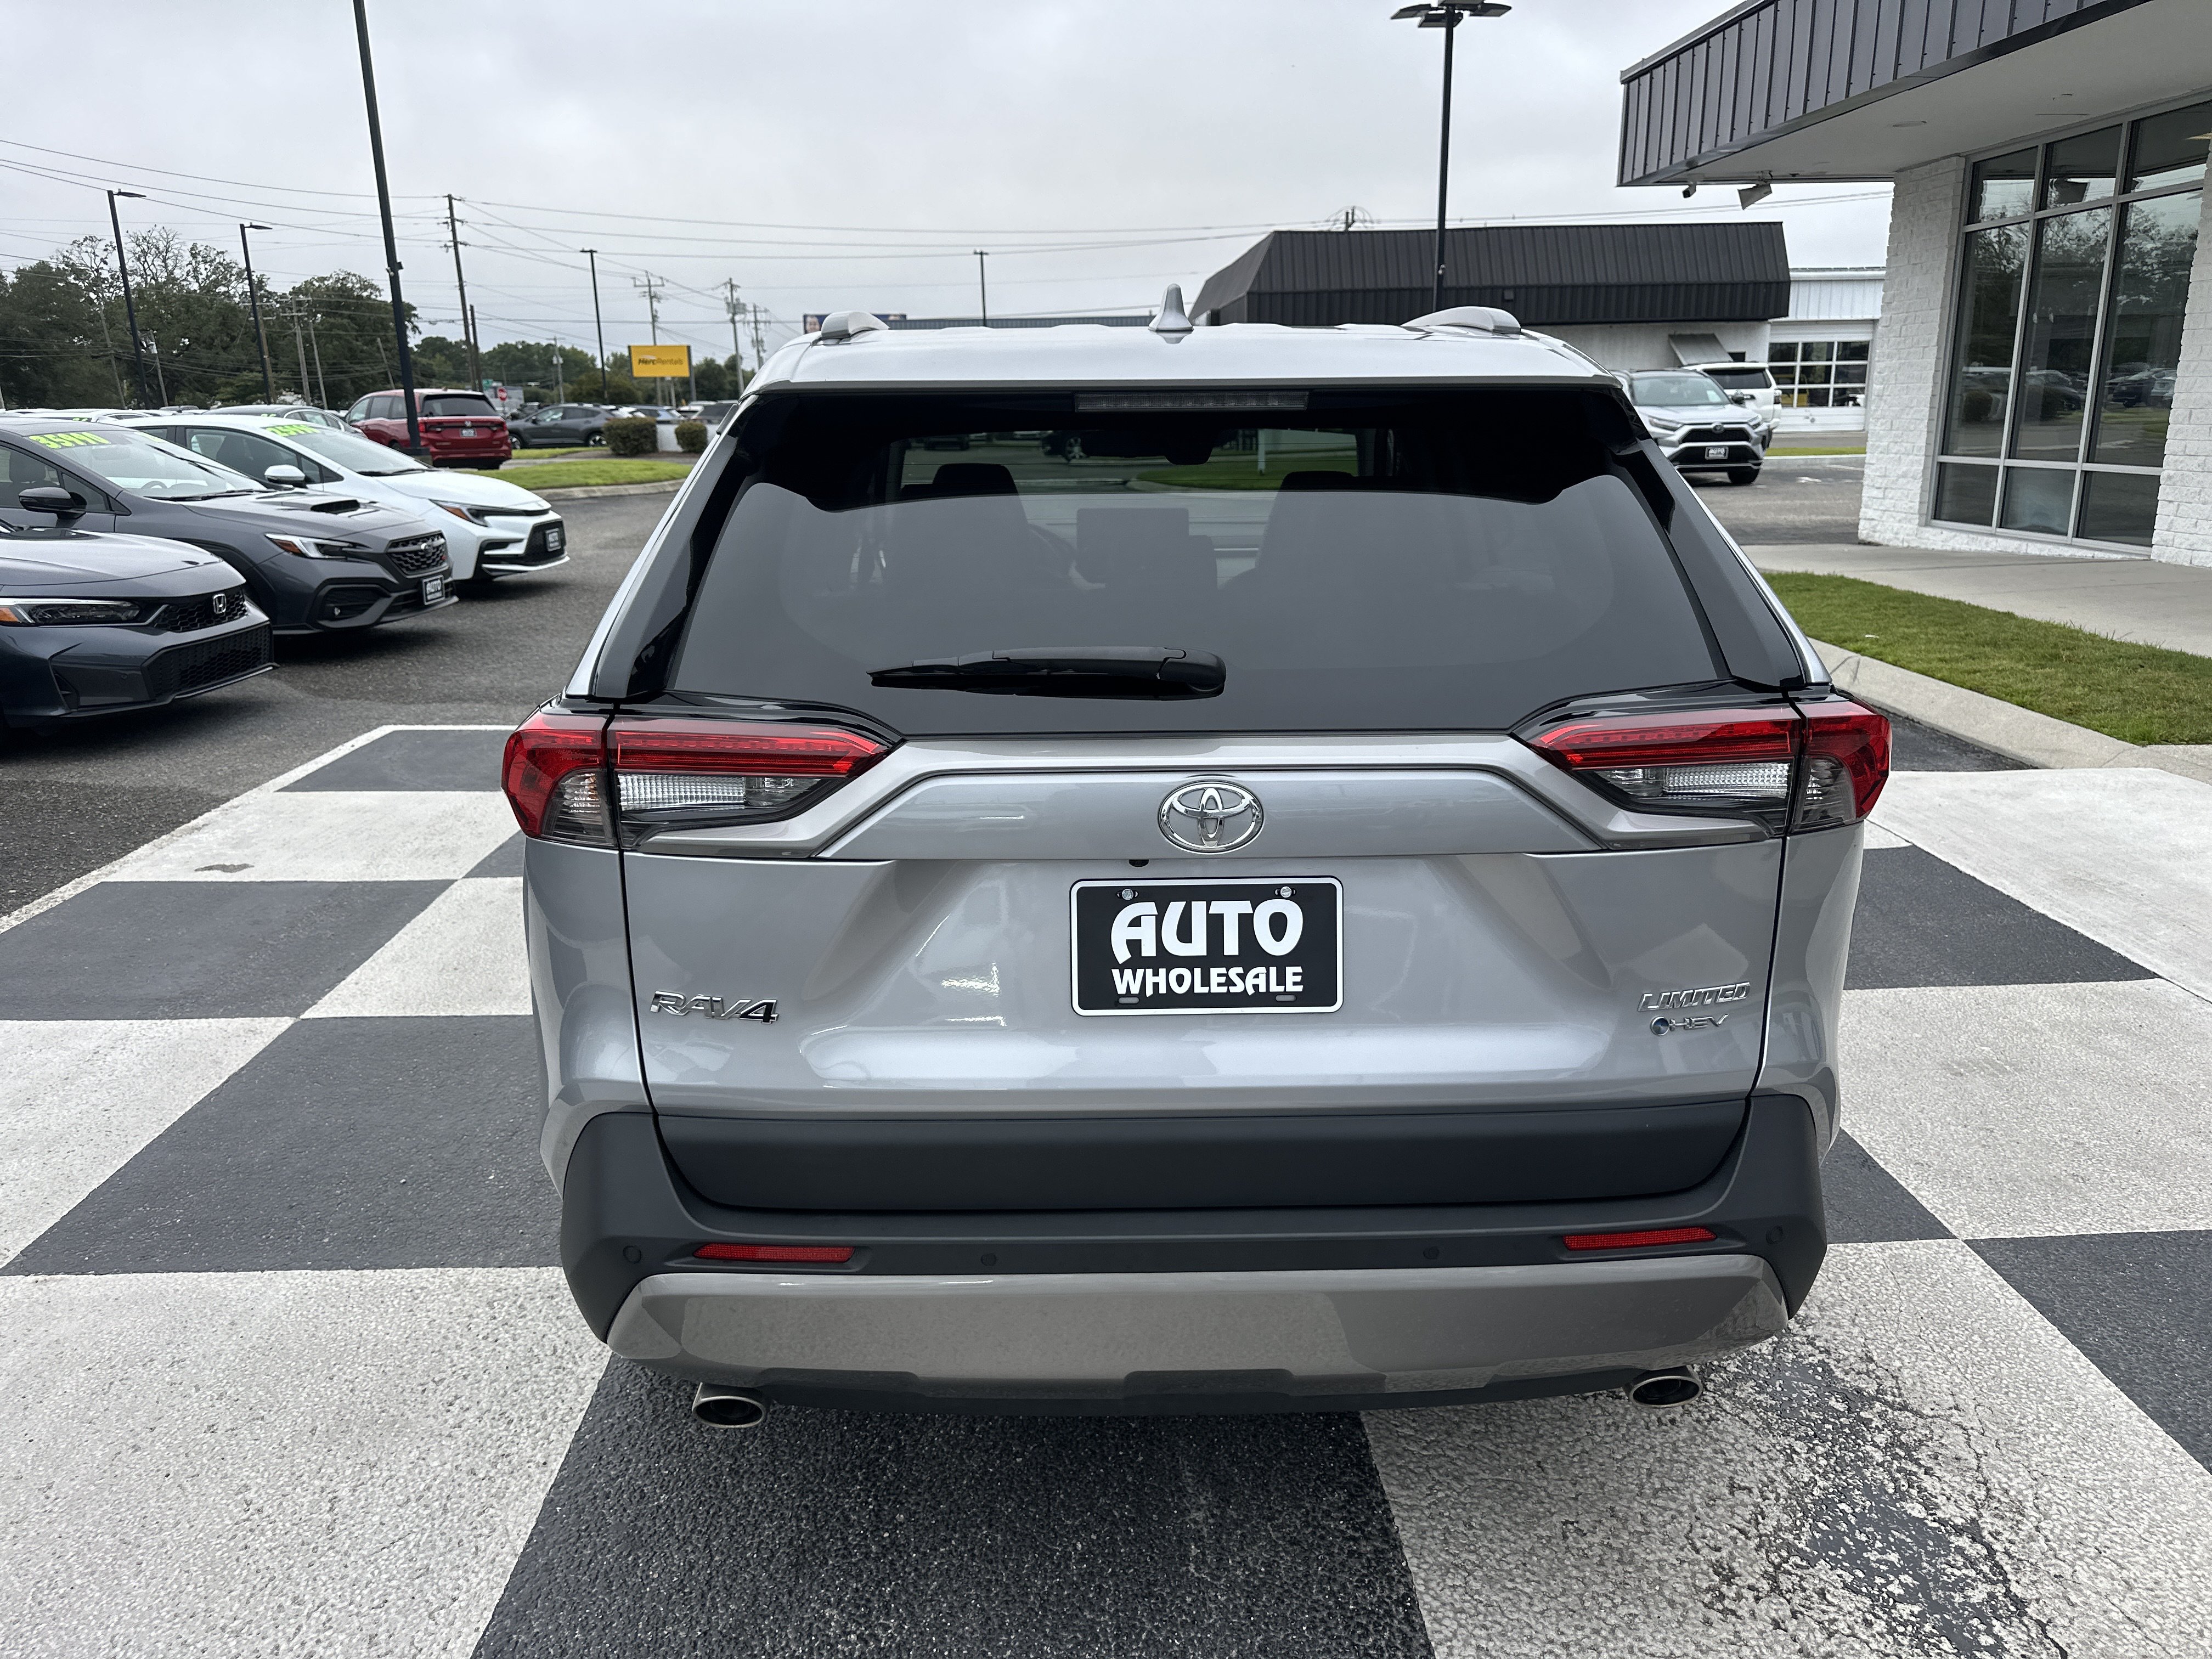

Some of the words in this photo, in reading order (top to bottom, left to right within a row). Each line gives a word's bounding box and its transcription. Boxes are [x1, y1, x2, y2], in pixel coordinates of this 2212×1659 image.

[29, 431, 112, 449] 35990
[1110, 898, 1304, 964] AUTO
[1111, 966, 1304, 997] WHOLESALE
[1637, 981, 1751, 1012] LIMITED
[650, 991, 778, 1025] RAV4
